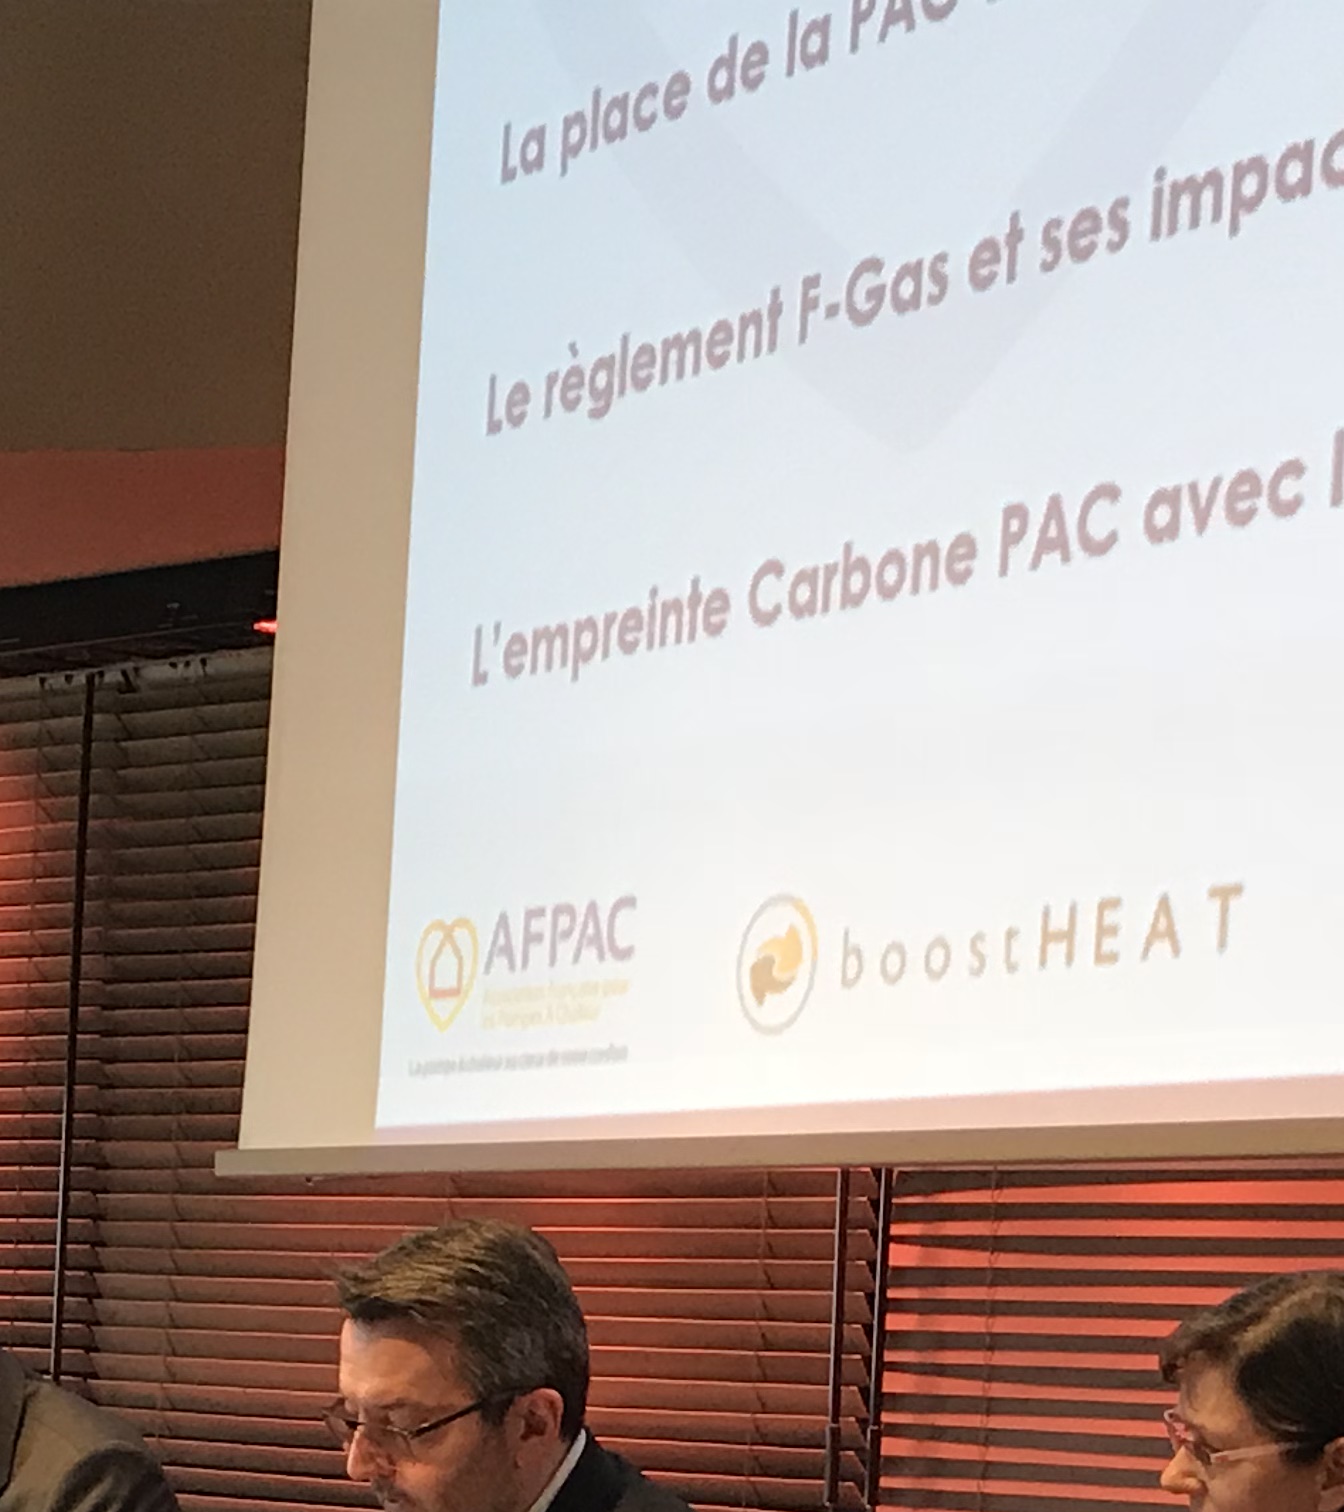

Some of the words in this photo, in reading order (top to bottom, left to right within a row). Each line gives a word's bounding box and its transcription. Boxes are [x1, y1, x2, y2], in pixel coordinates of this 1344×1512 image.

[500, 122, 546, 185] La
[560, 70, 691, 177] place
[707, 33, 770, 105] de
[785, 9, 831, 78] la
[485, 373, 530, 436] Le
[543, 285, 783, 419] règlement
[798, 251, 948, 345] F-Gas
[967, 211, 1025, 294] et
[1040, 196, 1131, 274] ses
[471, 575, 730, 688] L'empreinte
[747, 531, 977, 628] Carbone
[998, 481, 1122, 577] PAC
[1143, 456, 1306, 548] avec
[483, 893, 637, 975] AFPAC
